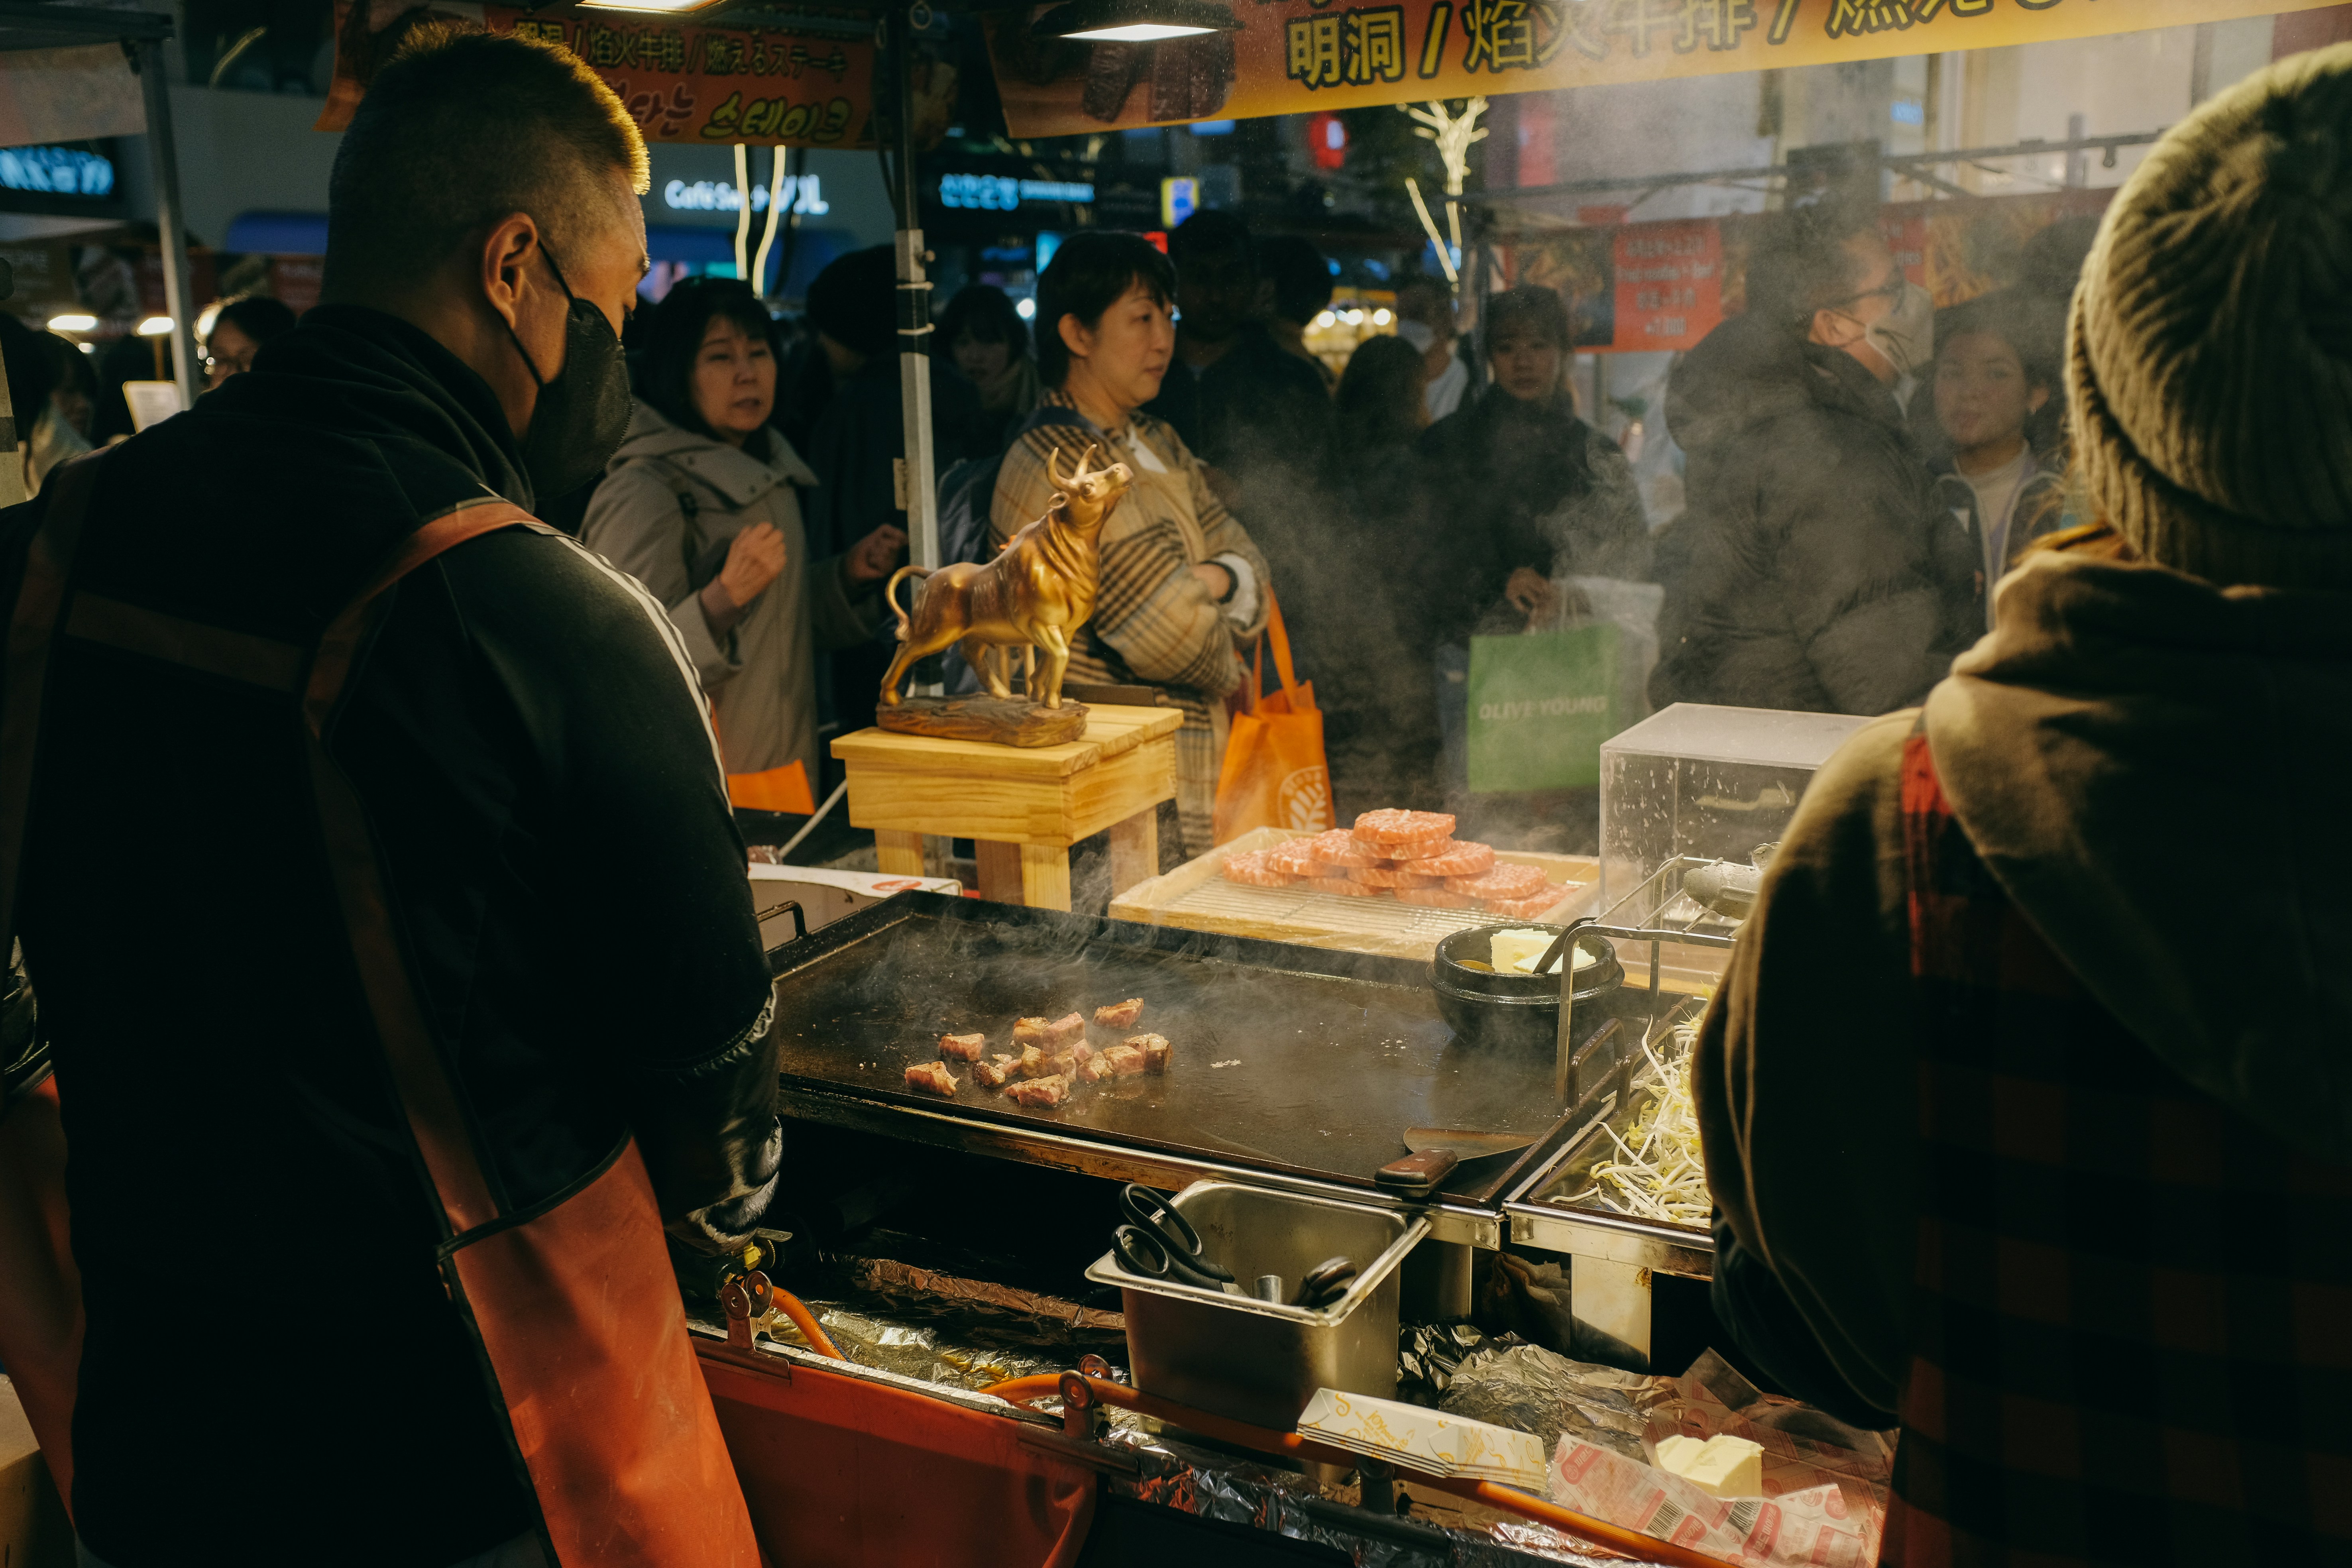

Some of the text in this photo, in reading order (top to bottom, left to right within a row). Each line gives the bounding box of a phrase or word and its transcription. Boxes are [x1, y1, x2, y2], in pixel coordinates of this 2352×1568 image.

[1287, 9, 1403, 88] 明洞
[700, 91, 852, 143] 스테이크
[1479, 696, 1607, 720] OLIVE YOUNG
